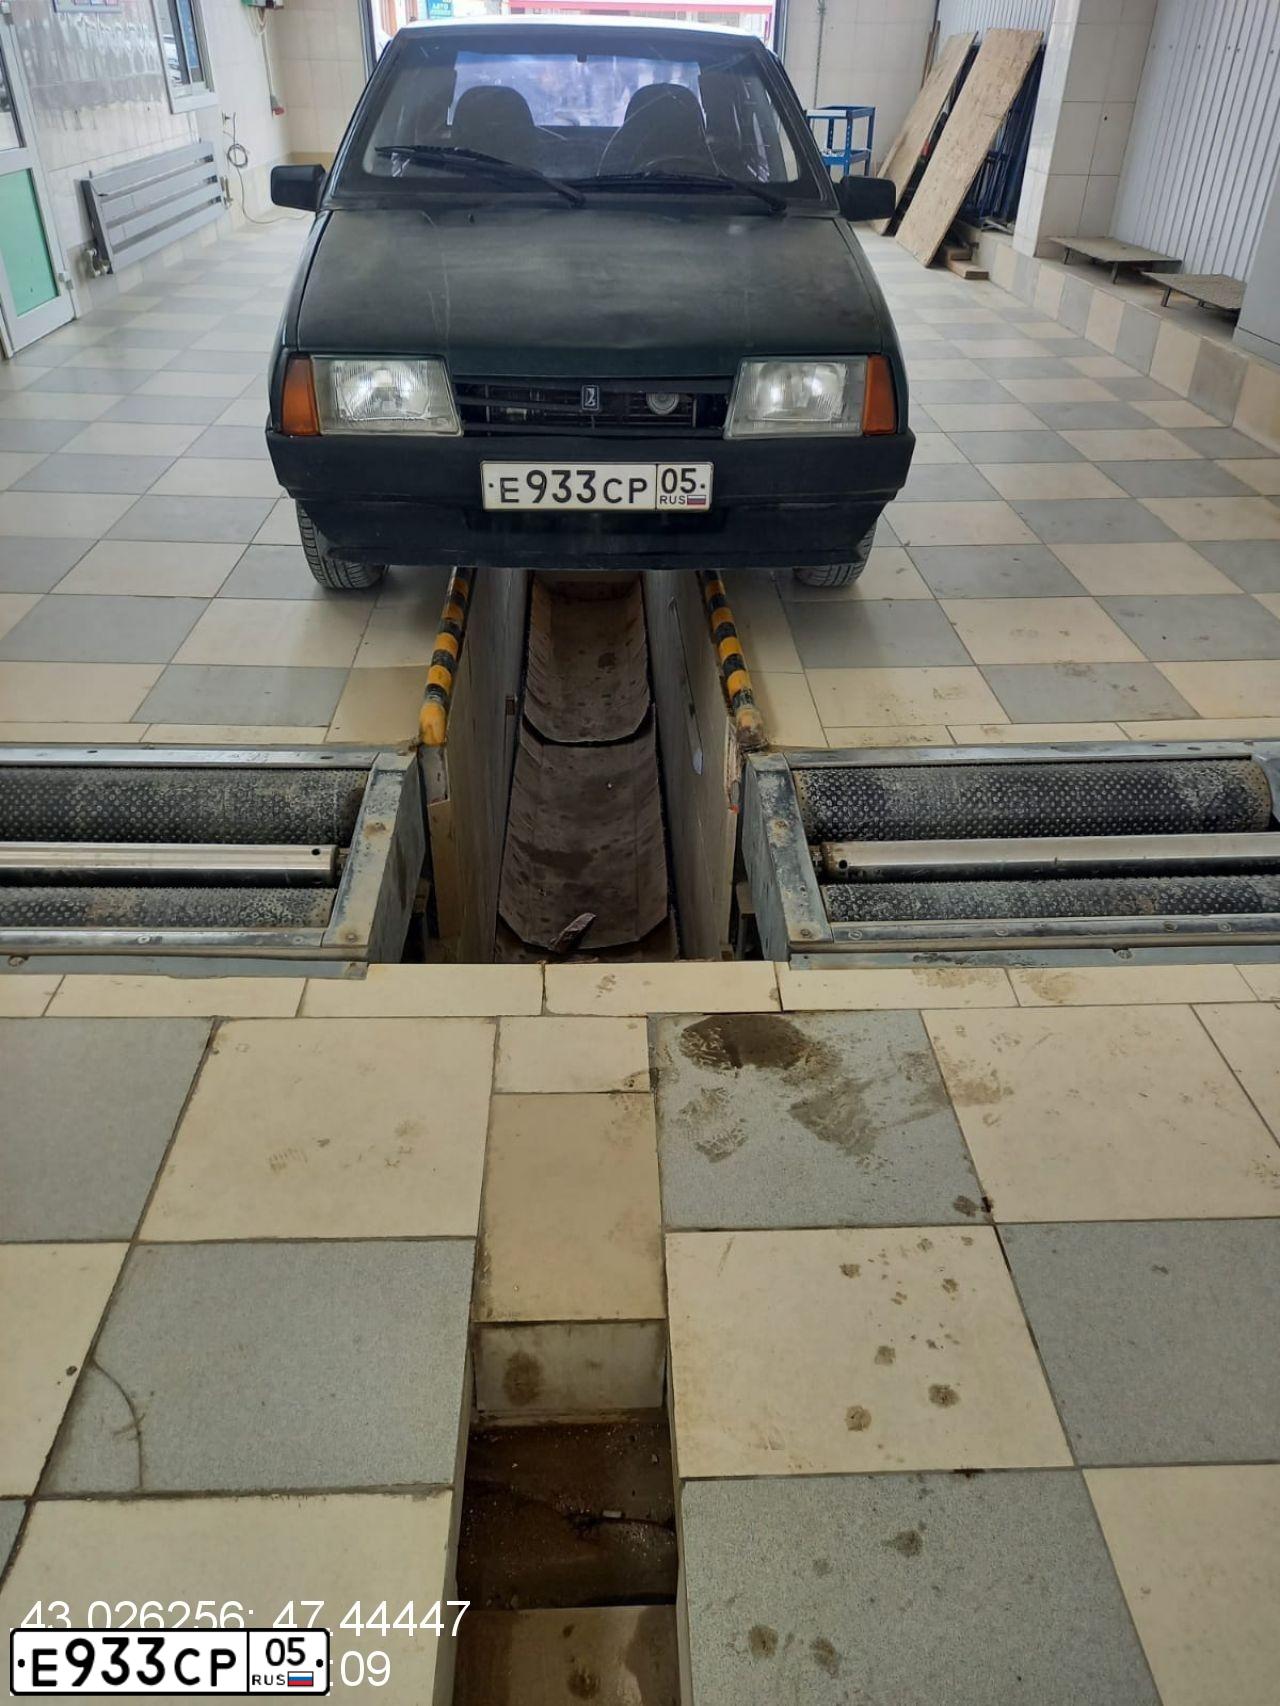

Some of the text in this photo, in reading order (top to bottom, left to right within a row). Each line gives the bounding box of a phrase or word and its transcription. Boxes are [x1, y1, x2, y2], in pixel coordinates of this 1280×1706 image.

[499, 467, 696, 504] Е933СР 05
[659, 495, 686, 505] RUS
